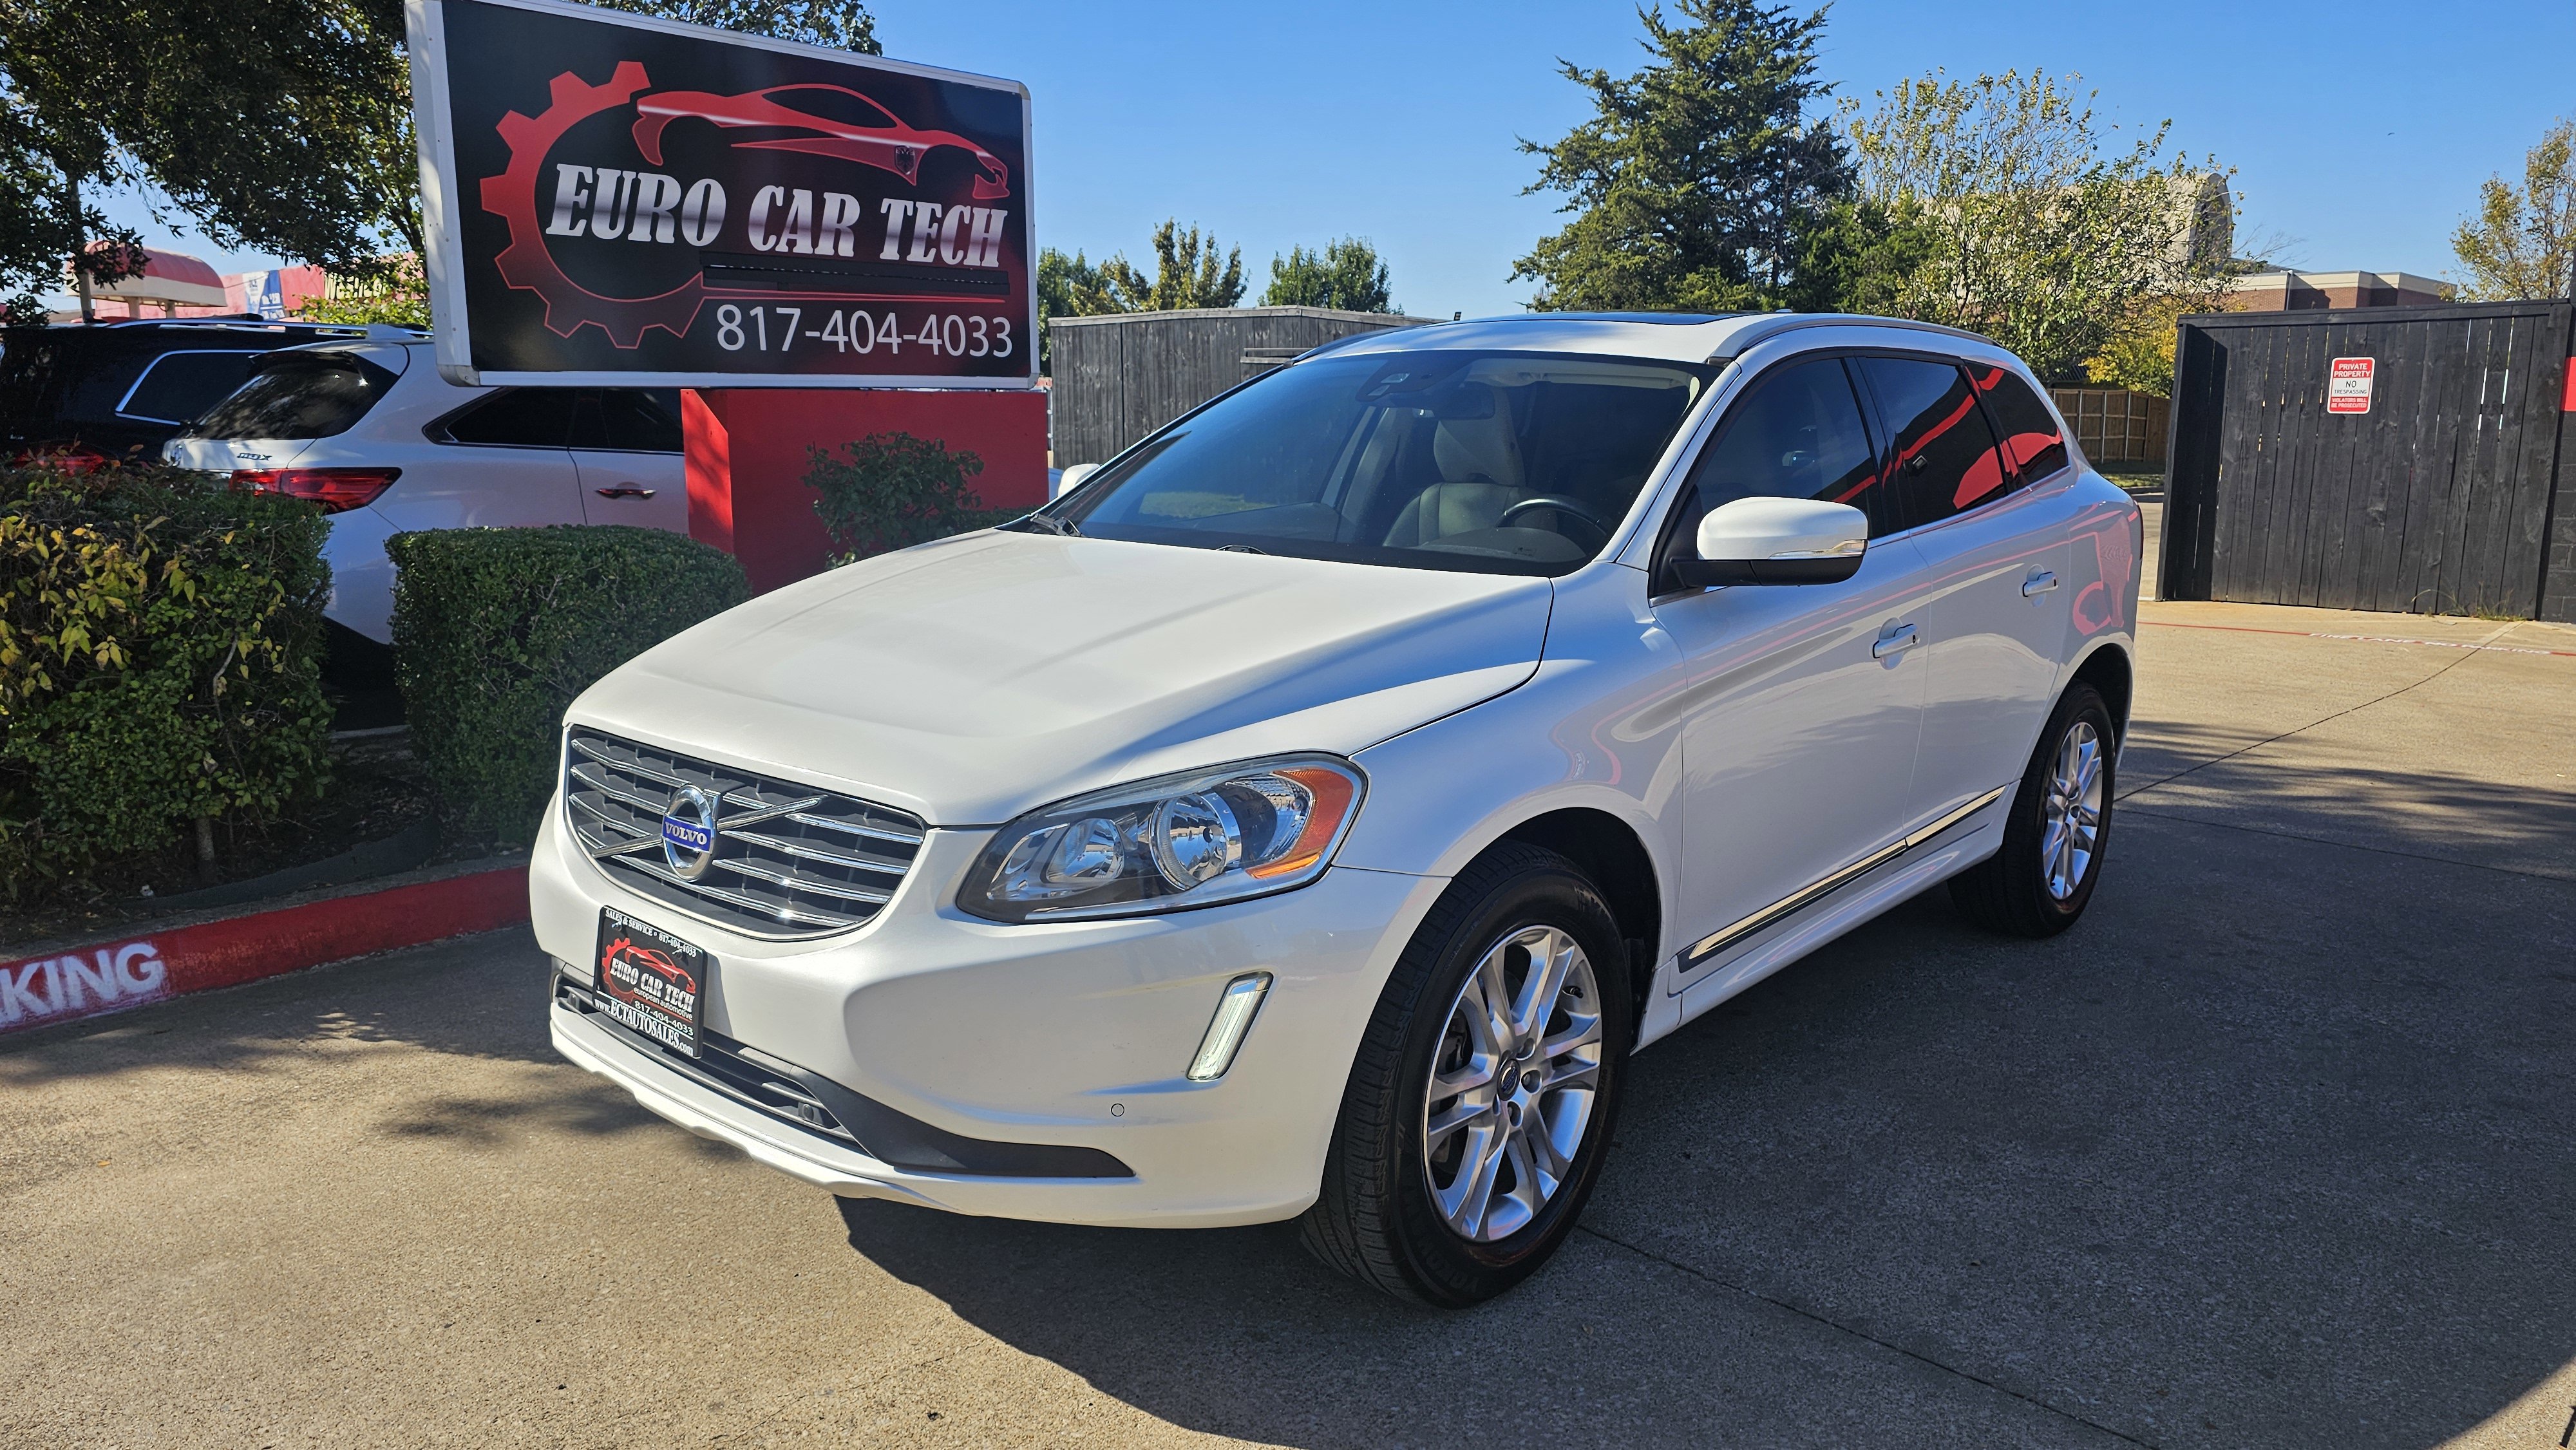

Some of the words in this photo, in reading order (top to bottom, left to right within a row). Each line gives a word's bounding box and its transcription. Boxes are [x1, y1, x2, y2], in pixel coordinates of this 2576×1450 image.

[545, 163, 726, 246] EURO
[748, 184, 861, 257] CAR
[879, 197, 1009, 268] TECH
[716, 303, 1013, 359] 817-404-4033
[665, 821, 708, 845] VOLVO
[605, 908, 623, 923] SALES
[622, 916, 629, 925] &
[628, 919, 653, 937] SERVICE
[610, 957, 639, 985] EURO
[640, 973, 663, 997] CAR
[664, 983, 695, 1013] TECH
[633, 987, 660, 1004] european
[659, 999, 693, 1021] automotive
[594, 999, 694, 1057] www.ECTAUTOSALES.com
[634, 1000, 694, 1036] 817-404-4033
